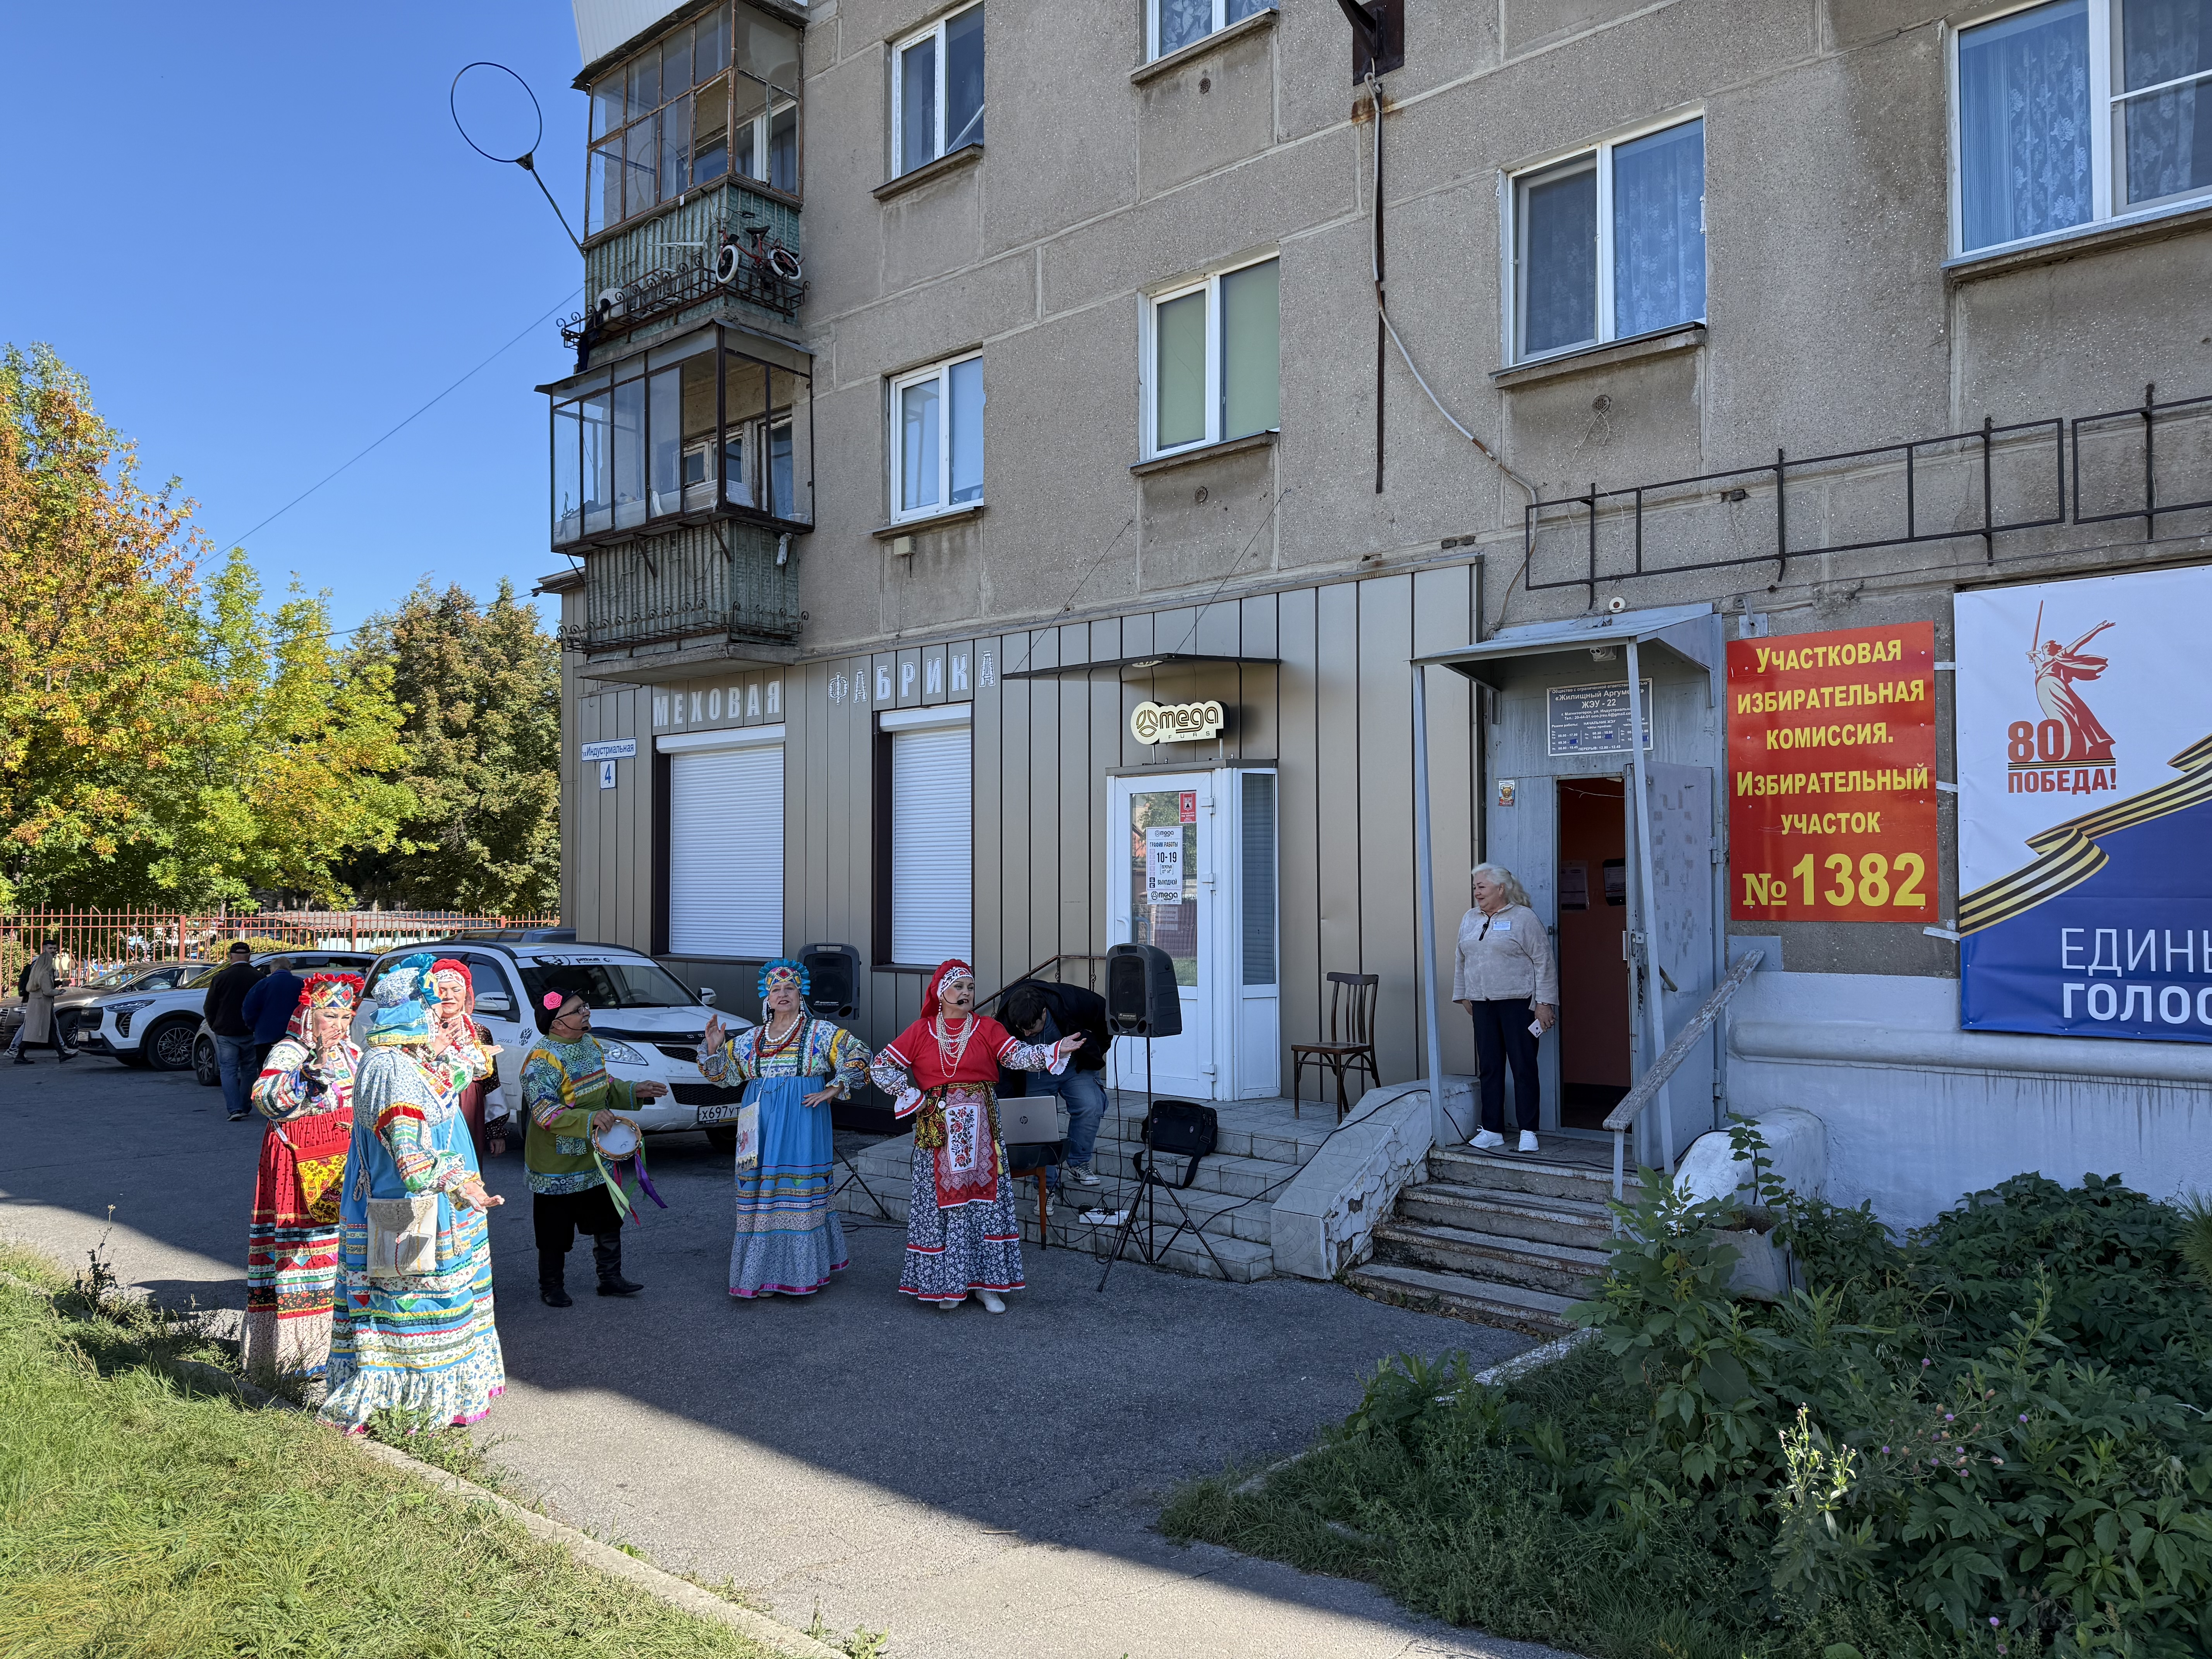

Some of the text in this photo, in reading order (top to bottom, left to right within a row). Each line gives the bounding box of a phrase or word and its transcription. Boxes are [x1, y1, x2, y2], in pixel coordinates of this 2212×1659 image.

[653, 650, 996, 726] МЕХОВАЯ ФАБРИКА
[1555, 689, 1644, 701] «Жилищный Аргуме»
[1738, 679, 1924, 714] ИЗБИРАТЕЛЬНАЯ
[1582, 700, 1600, 709] ЖЭУ
[1168, 731, 1210, 739] FURS
[1766, 722, 1894, 750] КОМИССИЯ.
[2008, 719, 2064, 763] 80
[586, 744, 634, 758] Индустриальная
[605, 764, 611, 783] 4
[2008, 768, 2116, 795] ПОБЕДА!
[1781, 812, 1881, 835] УЧАСТОК
[1157, 852, 1177, 863] 10-19
[1793, 852, 1926, 906] 1382
[2062, 927, 2212, 977] ЕДИН
